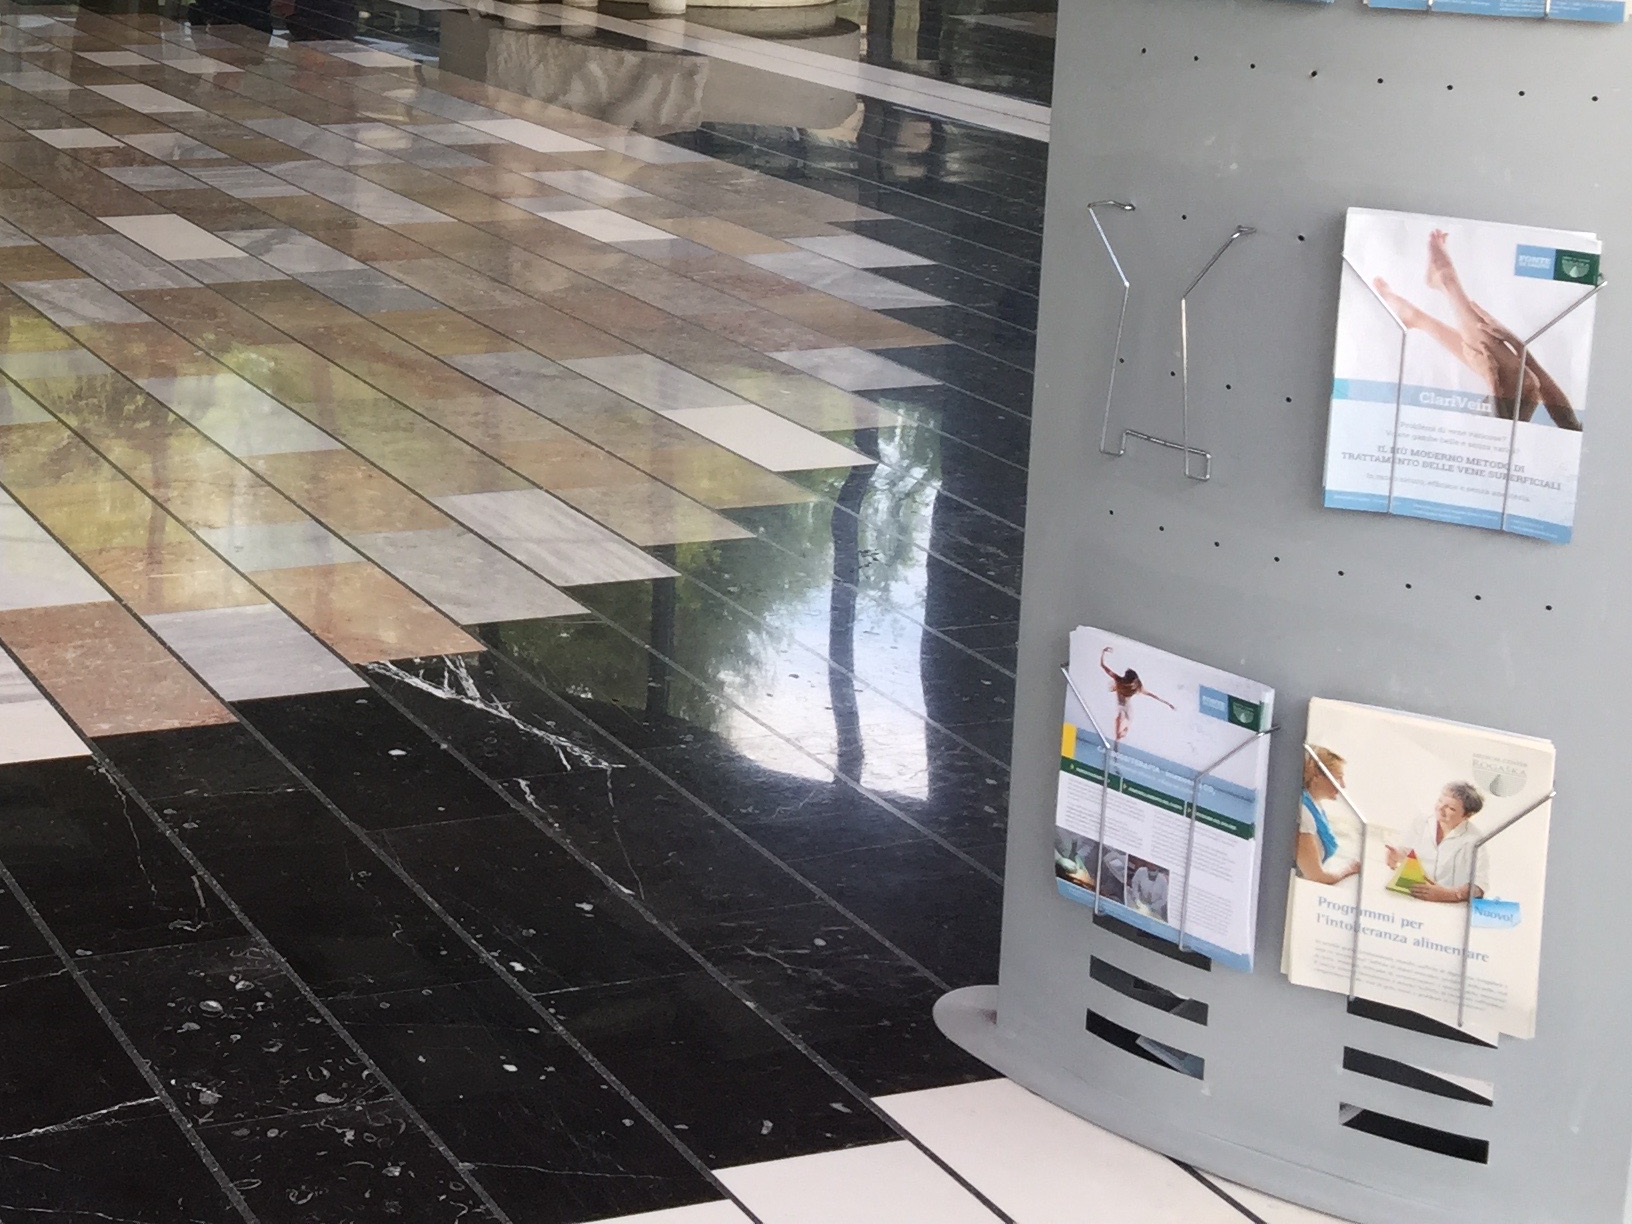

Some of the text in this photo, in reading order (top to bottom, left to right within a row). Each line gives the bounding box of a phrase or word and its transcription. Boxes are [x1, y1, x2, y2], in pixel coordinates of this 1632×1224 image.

[1419, 390, 1493, 414] ClariVein
[1341, 451, 1420, 467] TRATTAMNTO
[1421, 460, 1455, 473] DELLE
[1456, 465, 1486, 478] VENE
[1410, 448, 1464, 463] MODERNO
[1474, 905, 1514, 923] Nuovo!
[1400, 917, 1424, 930] per
